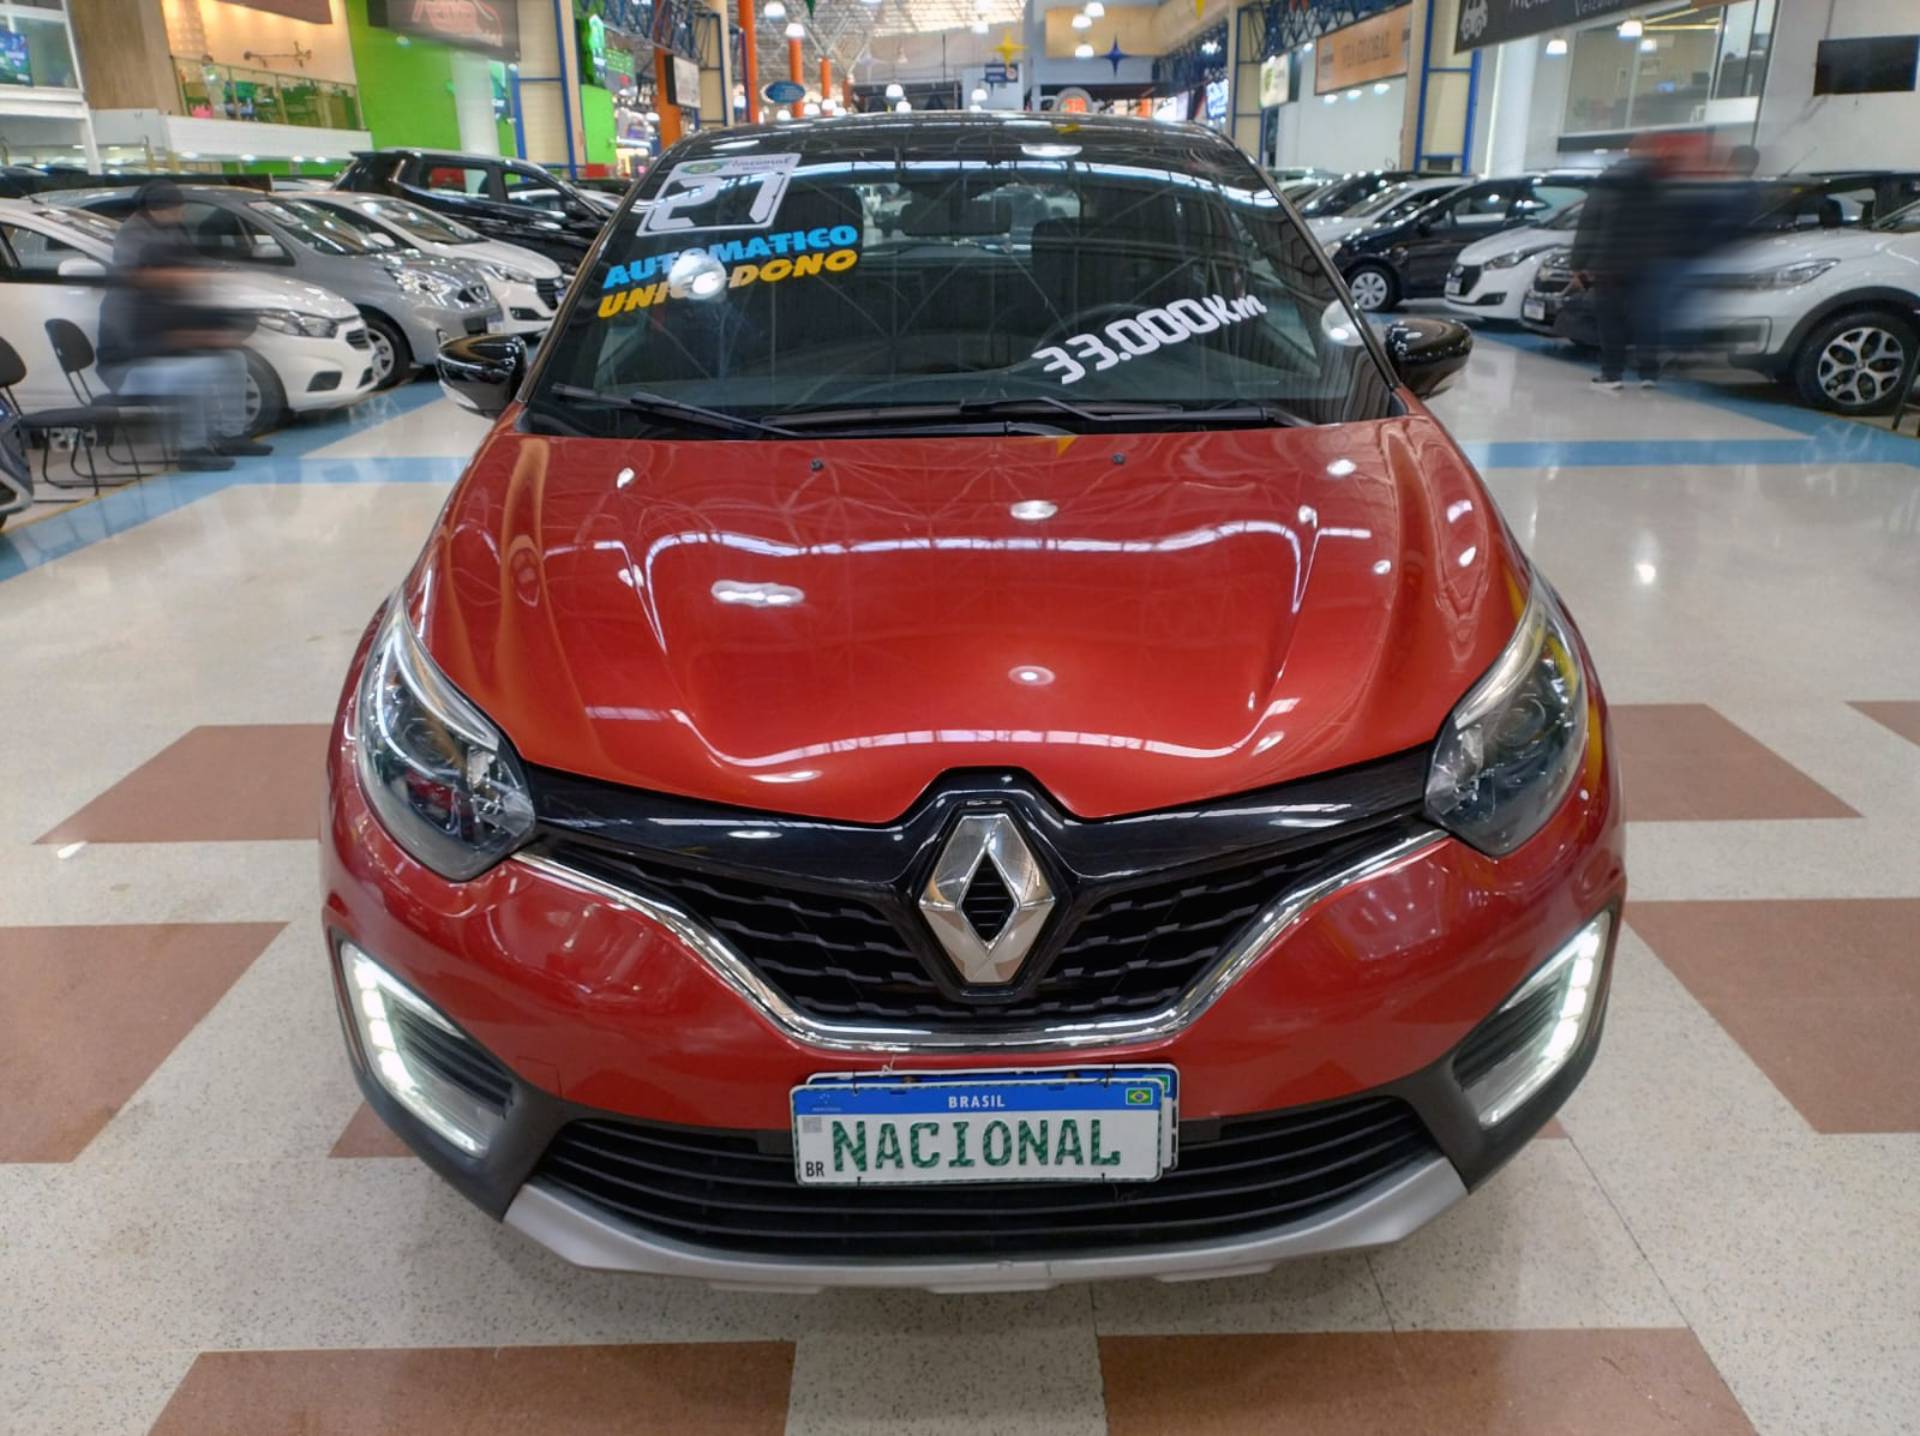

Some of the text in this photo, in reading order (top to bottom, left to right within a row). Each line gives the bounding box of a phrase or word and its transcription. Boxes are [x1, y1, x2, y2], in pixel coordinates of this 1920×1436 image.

[597, 249, 858, 319] UNI DONO
[948, 1095, 1006, 1109] BRASIL
[831, 1118, 1121, 1173] NACIONAL
[805, 1161, 825, 1178] BR
